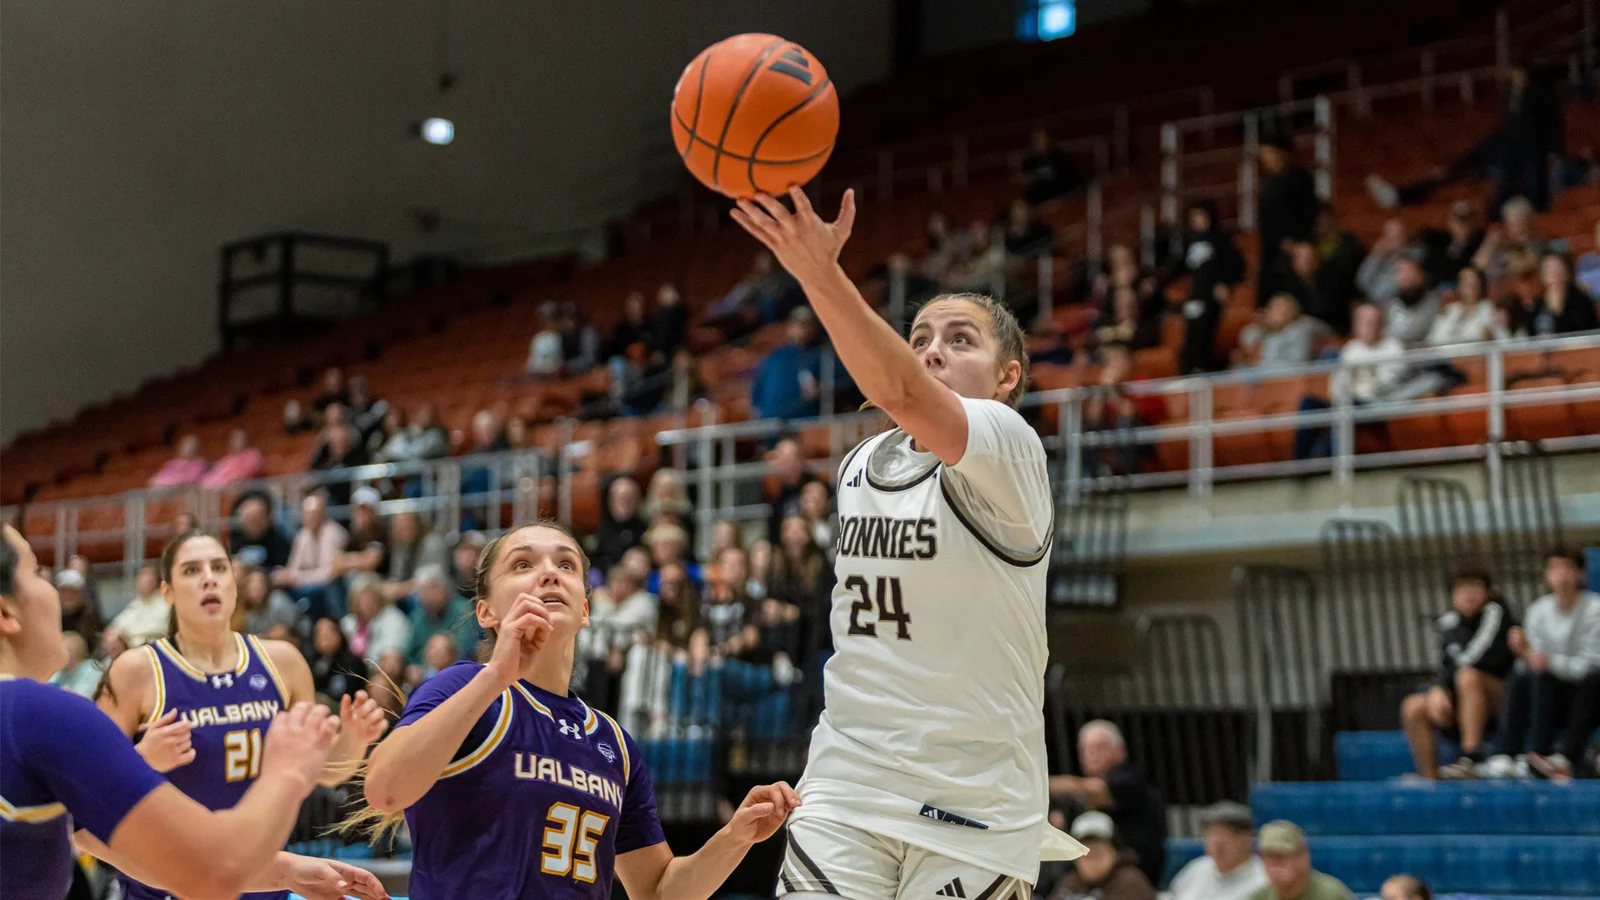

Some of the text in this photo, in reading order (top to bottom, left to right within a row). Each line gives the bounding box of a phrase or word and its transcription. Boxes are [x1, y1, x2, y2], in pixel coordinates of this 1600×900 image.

[844, 573, 912, 641] 24
[180, 699, 279, 729] UALBANY
[223, 727, 262, 783] 21
[513, 752, 624, 814] UALBANY
[541, 801, 611, 884] 35
